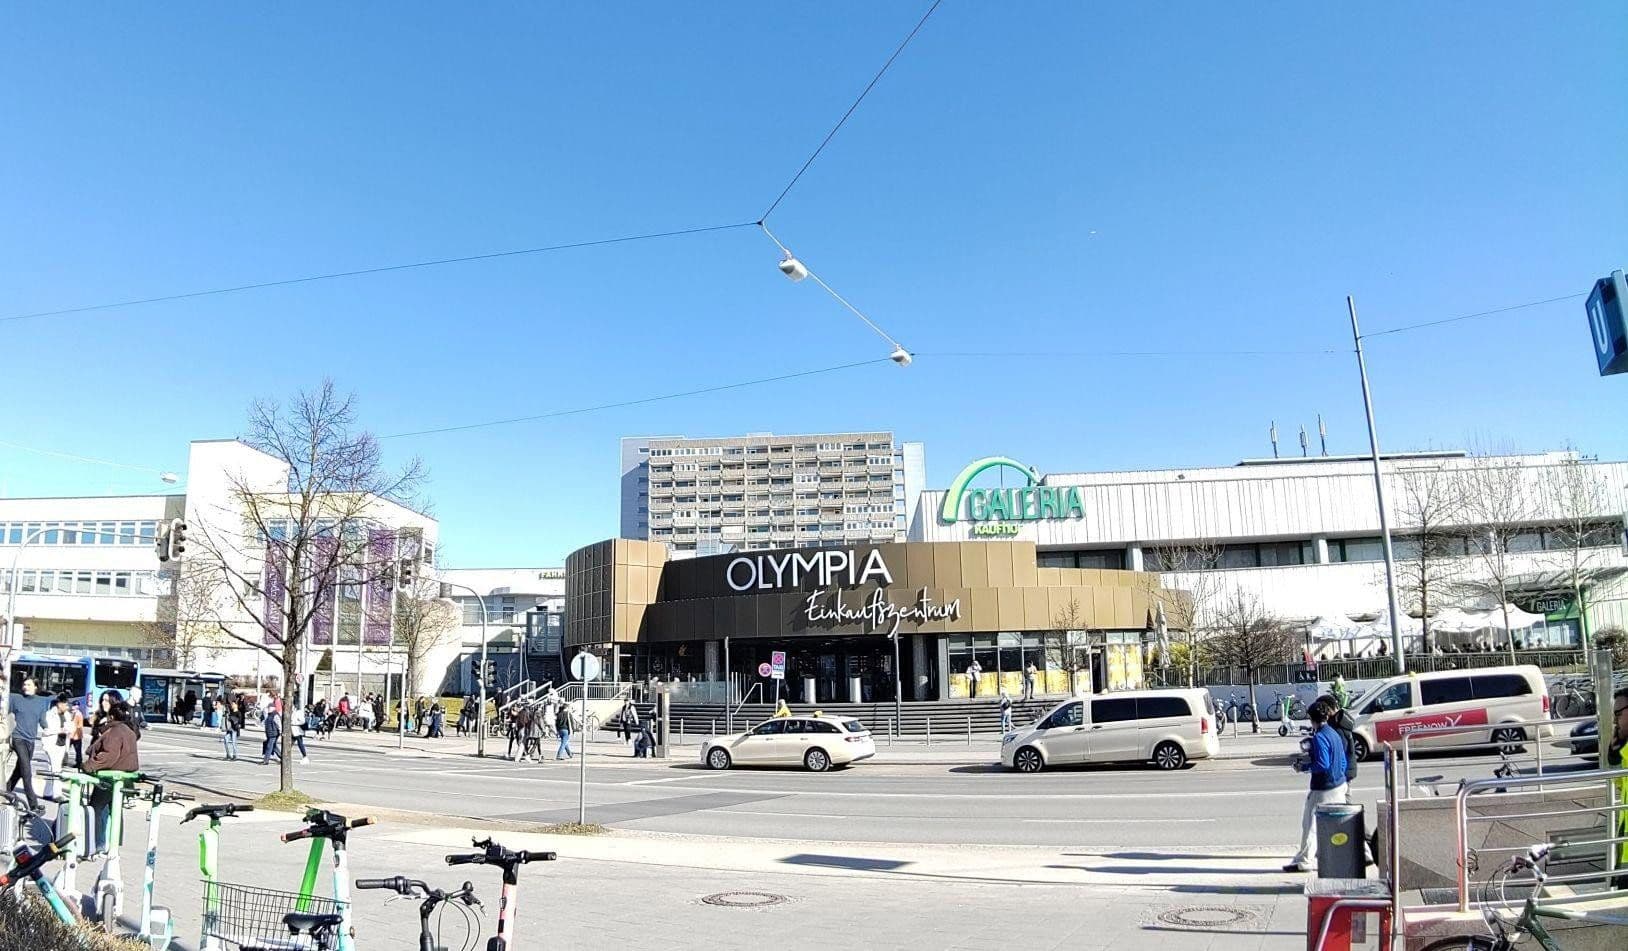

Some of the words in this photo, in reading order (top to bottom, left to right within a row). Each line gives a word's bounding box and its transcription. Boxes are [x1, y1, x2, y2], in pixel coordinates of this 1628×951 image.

[1592, 299, 1609, 354] U
[969, 486, 1084, 521] GALERIA
[726, 549, 893, 591] OLYMPIA
[804, 587, 961, 638] Einkaufszentrum
[1536, 599, 1567, 611] GALERIA
